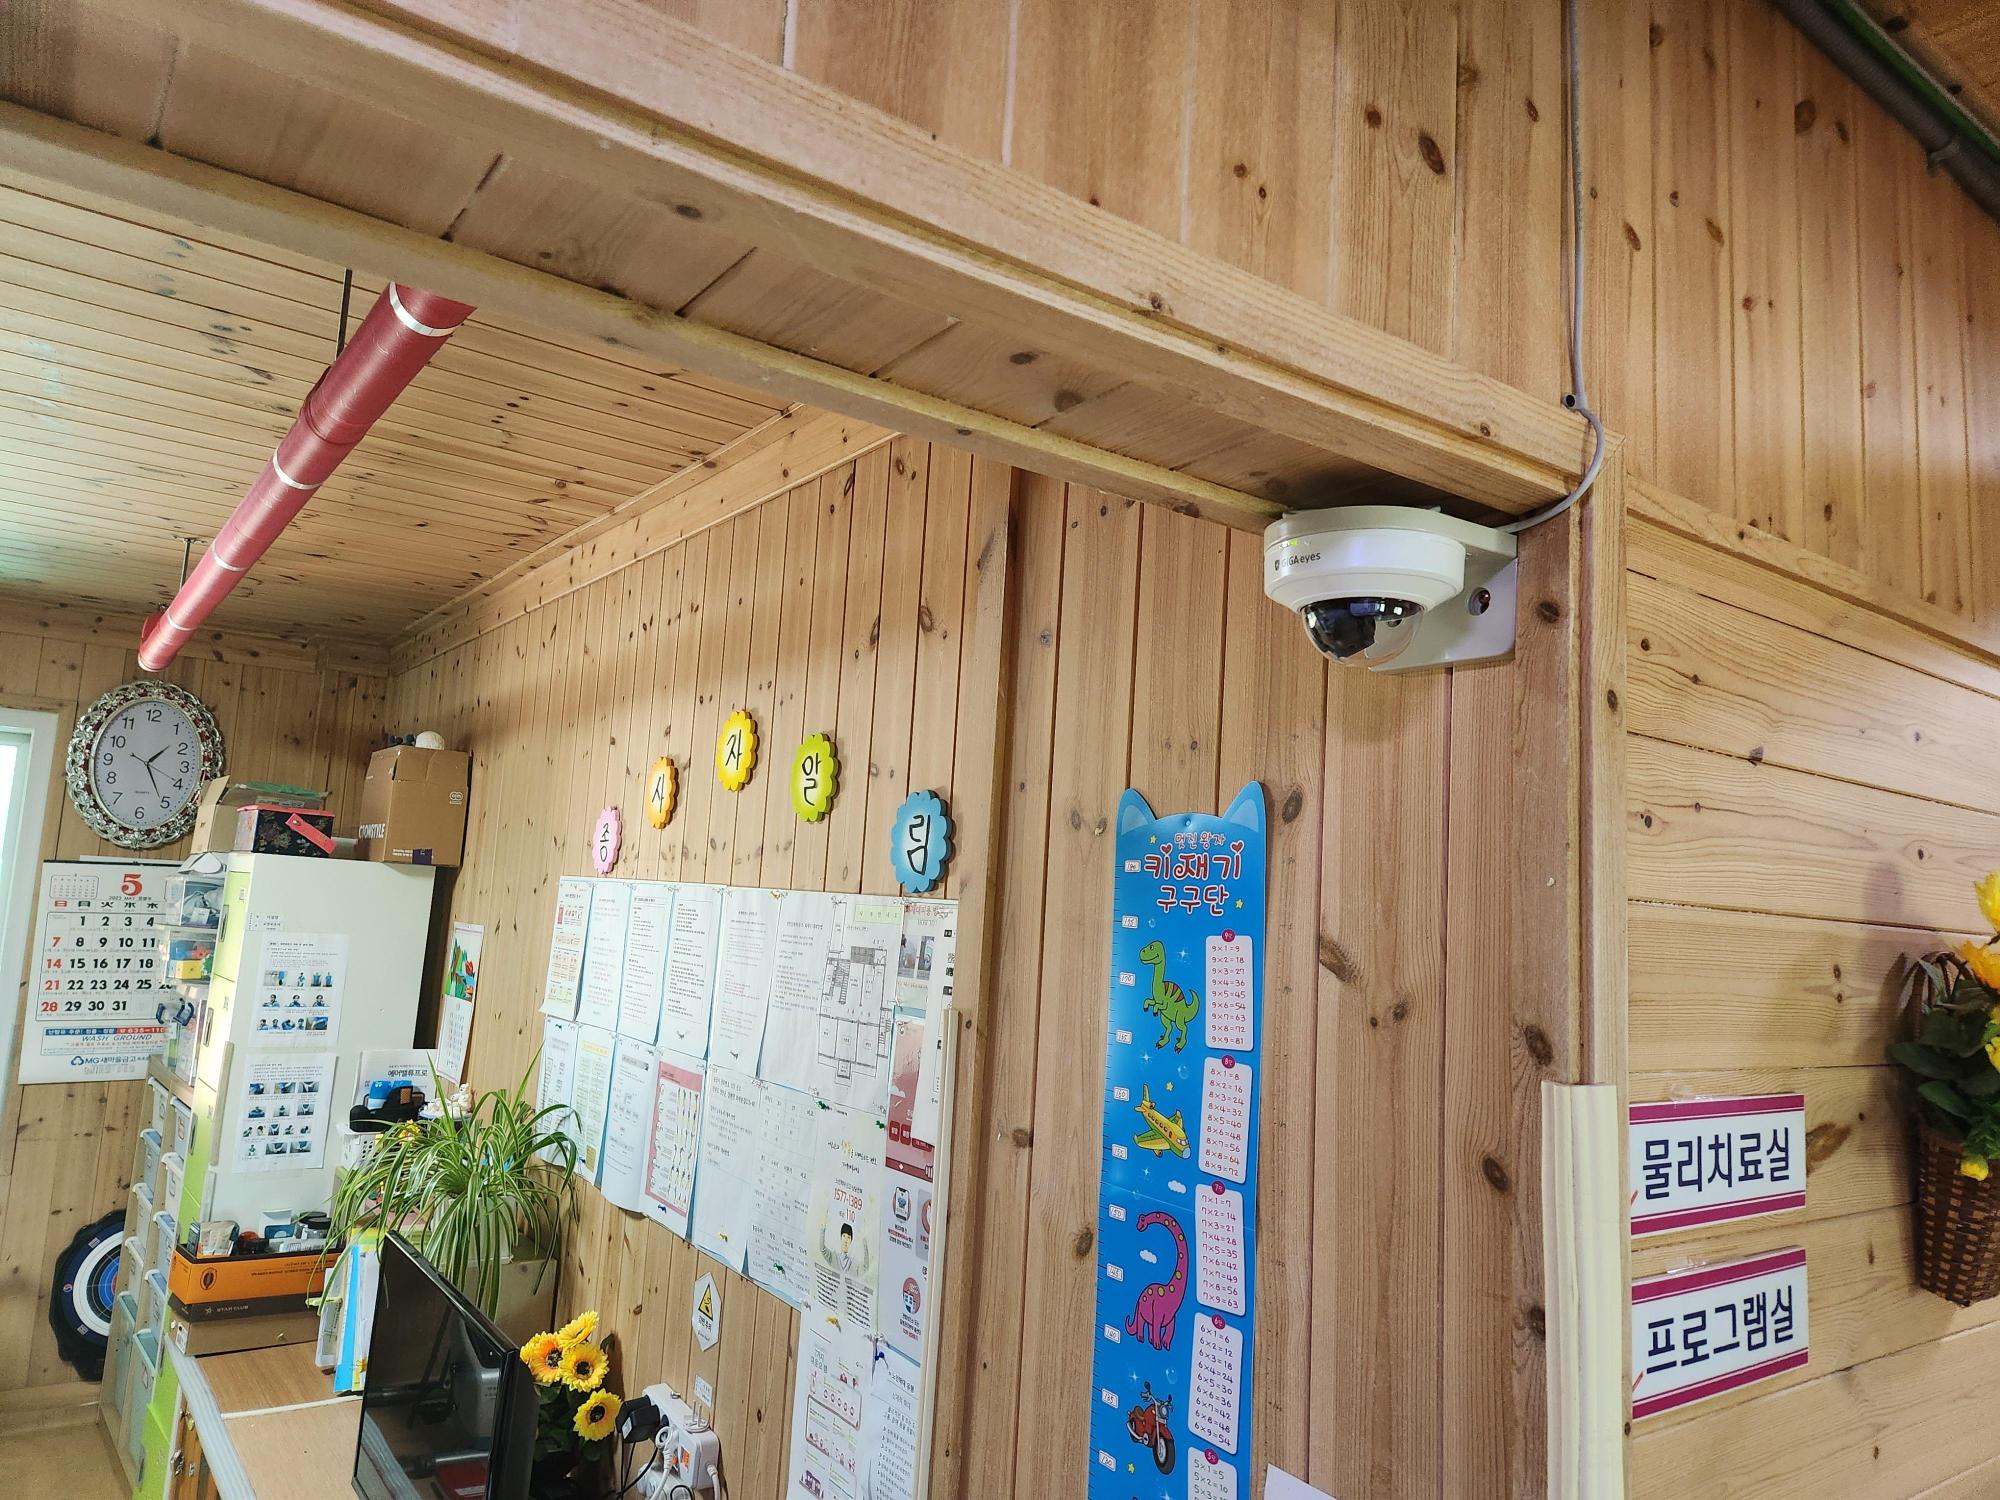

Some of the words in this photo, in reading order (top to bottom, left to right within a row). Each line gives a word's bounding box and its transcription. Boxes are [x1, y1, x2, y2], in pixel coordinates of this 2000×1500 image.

[146, 709, 163, 722] 12
[123, 717, 135, 730] 11
[173, 723, 179, 735] 1
[110, 736, 126, 748] 10
[177, 743, 189, 755] 2
[103, 753, 114, 765] 9
[180, 761, 190, 773] 3
[106, 772, 117, 784] 8
[173, 778, 184, 790] 4
[112, 792, 123, 804] 7
[160, 797, 170, 809] 5
[599, 823, 610, 862] 종
[652, 773, 665, 814] 사
[725, 729, 743, 771] 자
[802, 752, 821, 807] 알
[906, 814, 931, 875] 림
[134, 807, 145, 819] 6
[1175, 832, 1198, 850] 멋진
[1200, 831, 1226, 850] 왕자
[1144, 847, 1245, 881] 키재기
[121, 874, 143, 896] 5
[1156, 884, 1230, 917] 구구단
[80, 916, 86, 926] 1
[102, 916, 110, 926] 2
[124, 916, 132, 926] 3
[146, 917, 154, 927] 4
[52, 937, 61, 947] 7
[76, 937, 84, 947] 8
[99, 937, 107, 947] 9
[119, 938, 134, 947] 10
[142, 938, 155, 947] 11
[47, 959, 62, 968] 14
[70, 959, 86, 968] 15
[93, 959, 108, 968] 16
[116, 959, 132, 968] 17
[139, 959, 154, 968] 18
[45, 980, 60, 990] 21
[67, 980, 84, 990] 22
[90, 980, 107, 990] 23
[113, 979, 129, 990] 24
[136, 979, 152, 990] 25
[41, 1001, 58, 1012] 28
[64, 1001, 82, 1011] 29
[88, 1001, 105, 1011] 30
[112, 1001, 127, 1011] 31
[1642, 1126, 1790, 1200] 물리치료실
[834, 1187, 863, 1210] 1577-1389
[1646, 1285, 1794, 1374] 프로그램실
